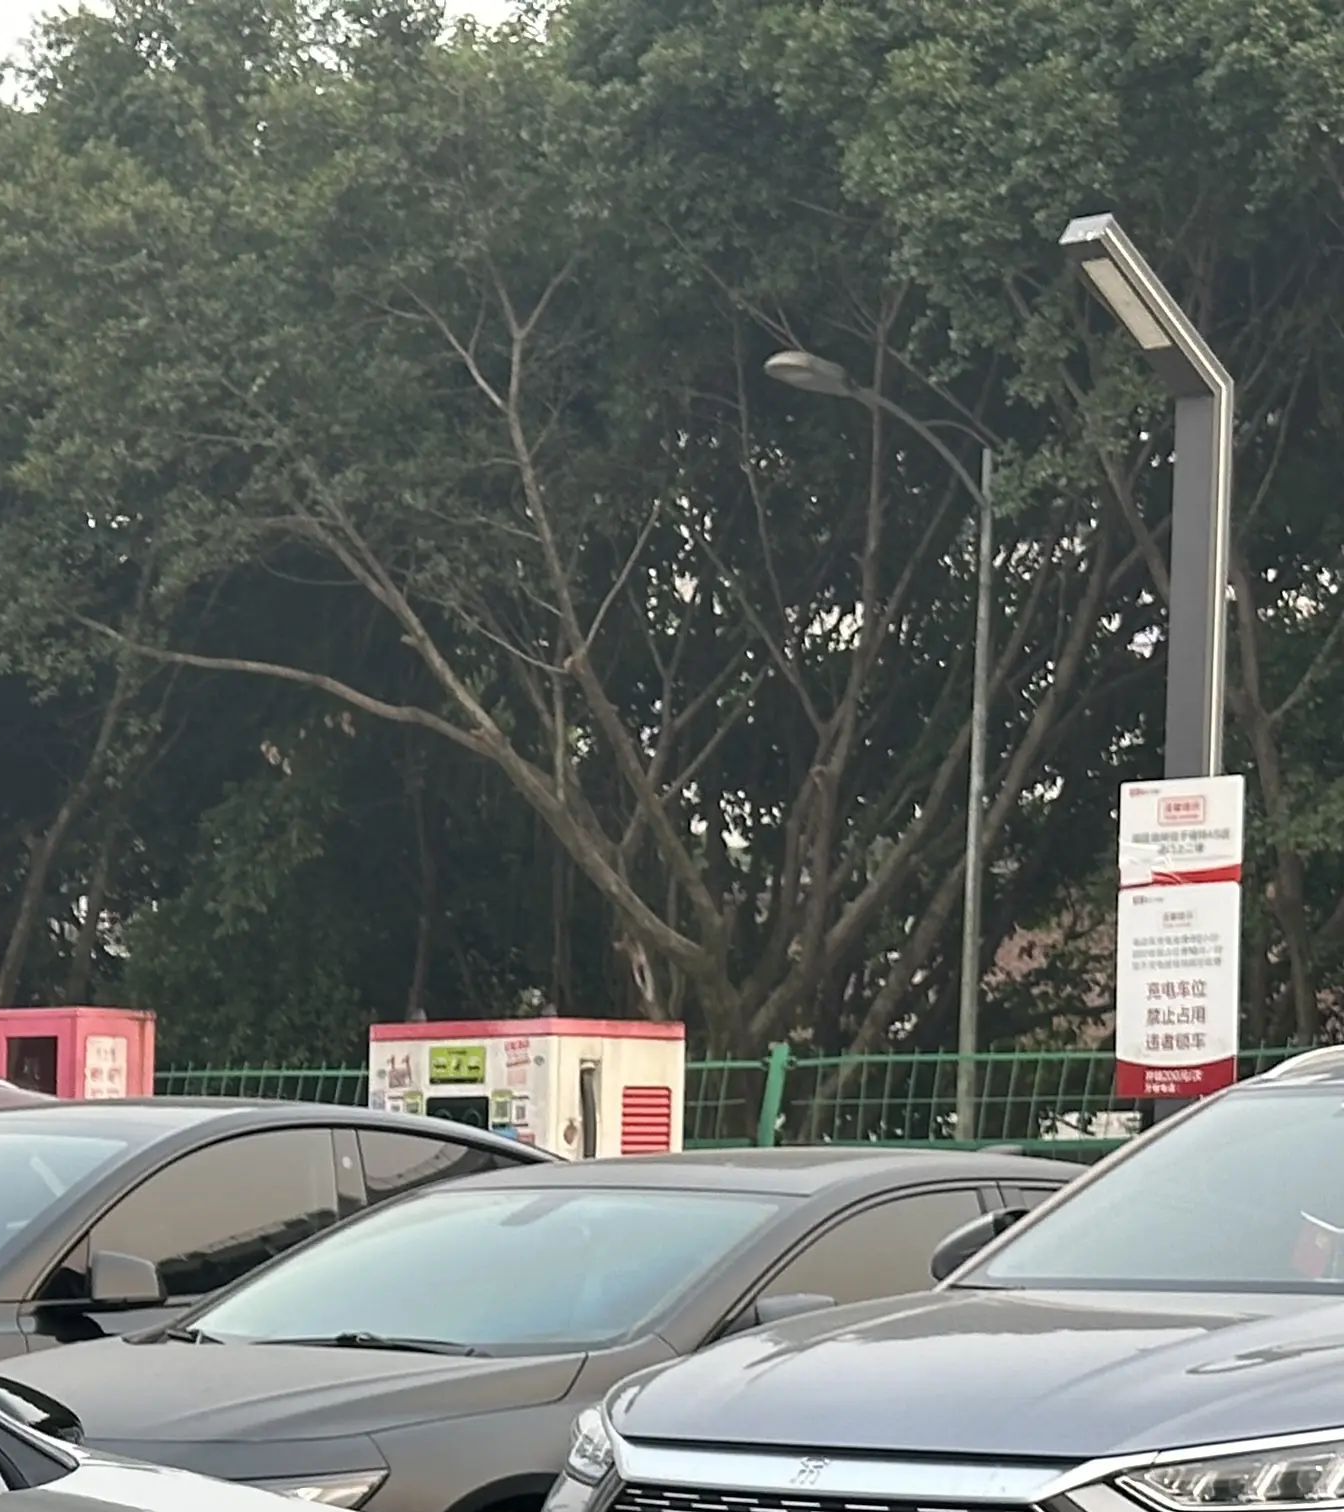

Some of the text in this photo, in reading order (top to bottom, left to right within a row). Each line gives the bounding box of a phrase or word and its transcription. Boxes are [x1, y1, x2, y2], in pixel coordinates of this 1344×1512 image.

[1146, 979, 1207, 1000] 充电车位
[1146, 1005, 1206, 1026] 禁止占用
